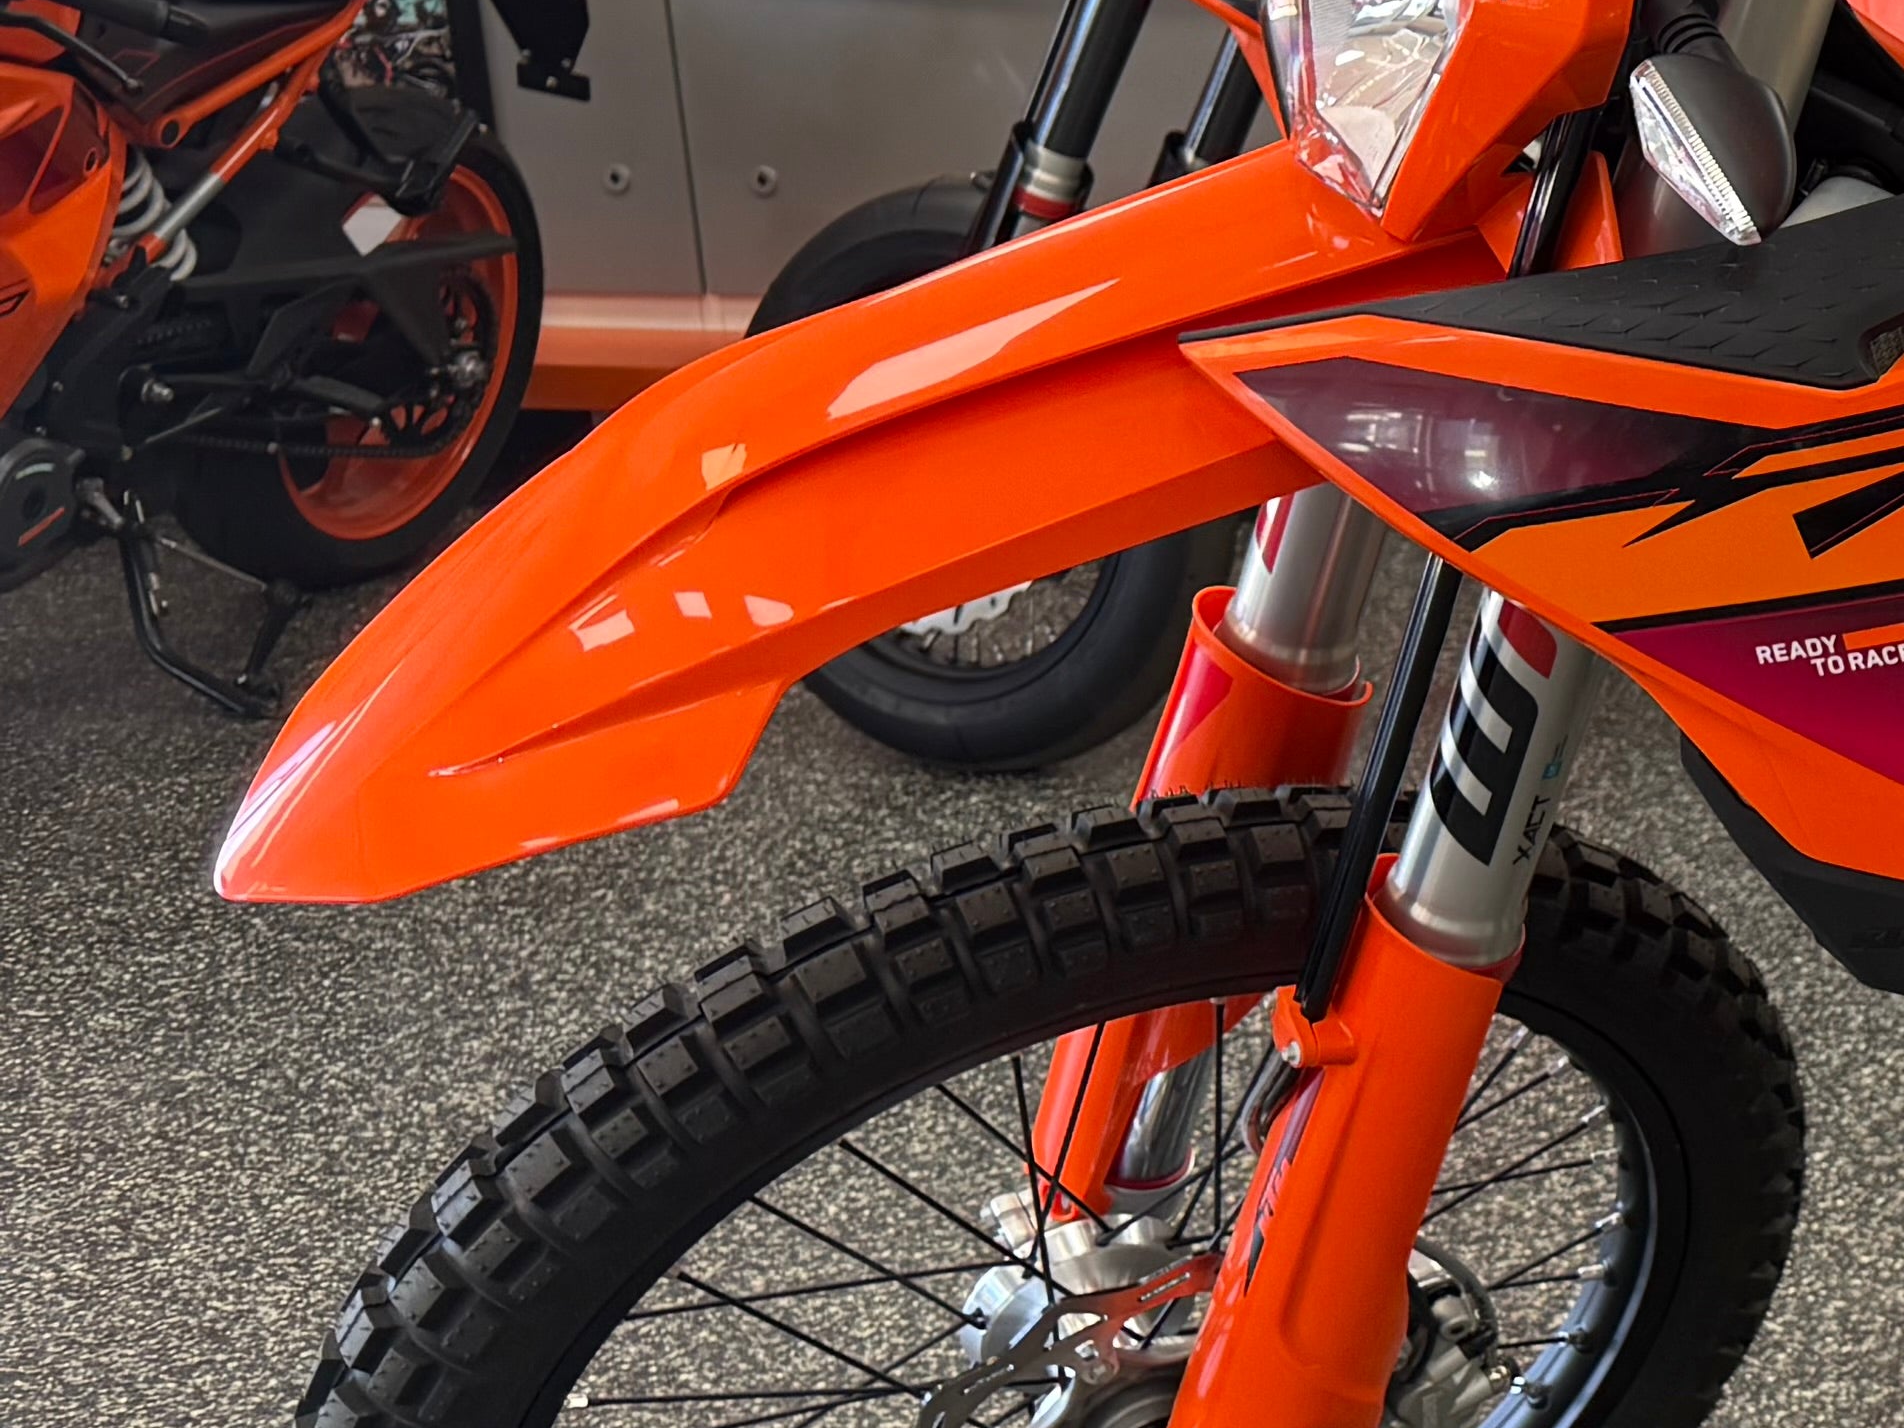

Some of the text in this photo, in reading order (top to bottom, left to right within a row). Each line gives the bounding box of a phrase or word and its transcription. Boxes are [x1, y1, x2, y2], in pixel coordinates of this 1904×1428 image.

[1755, 634, 1836, 665] READY
[1810, 655, 1845, 677] TO
[1511, 794, 1552, 866] XACT
